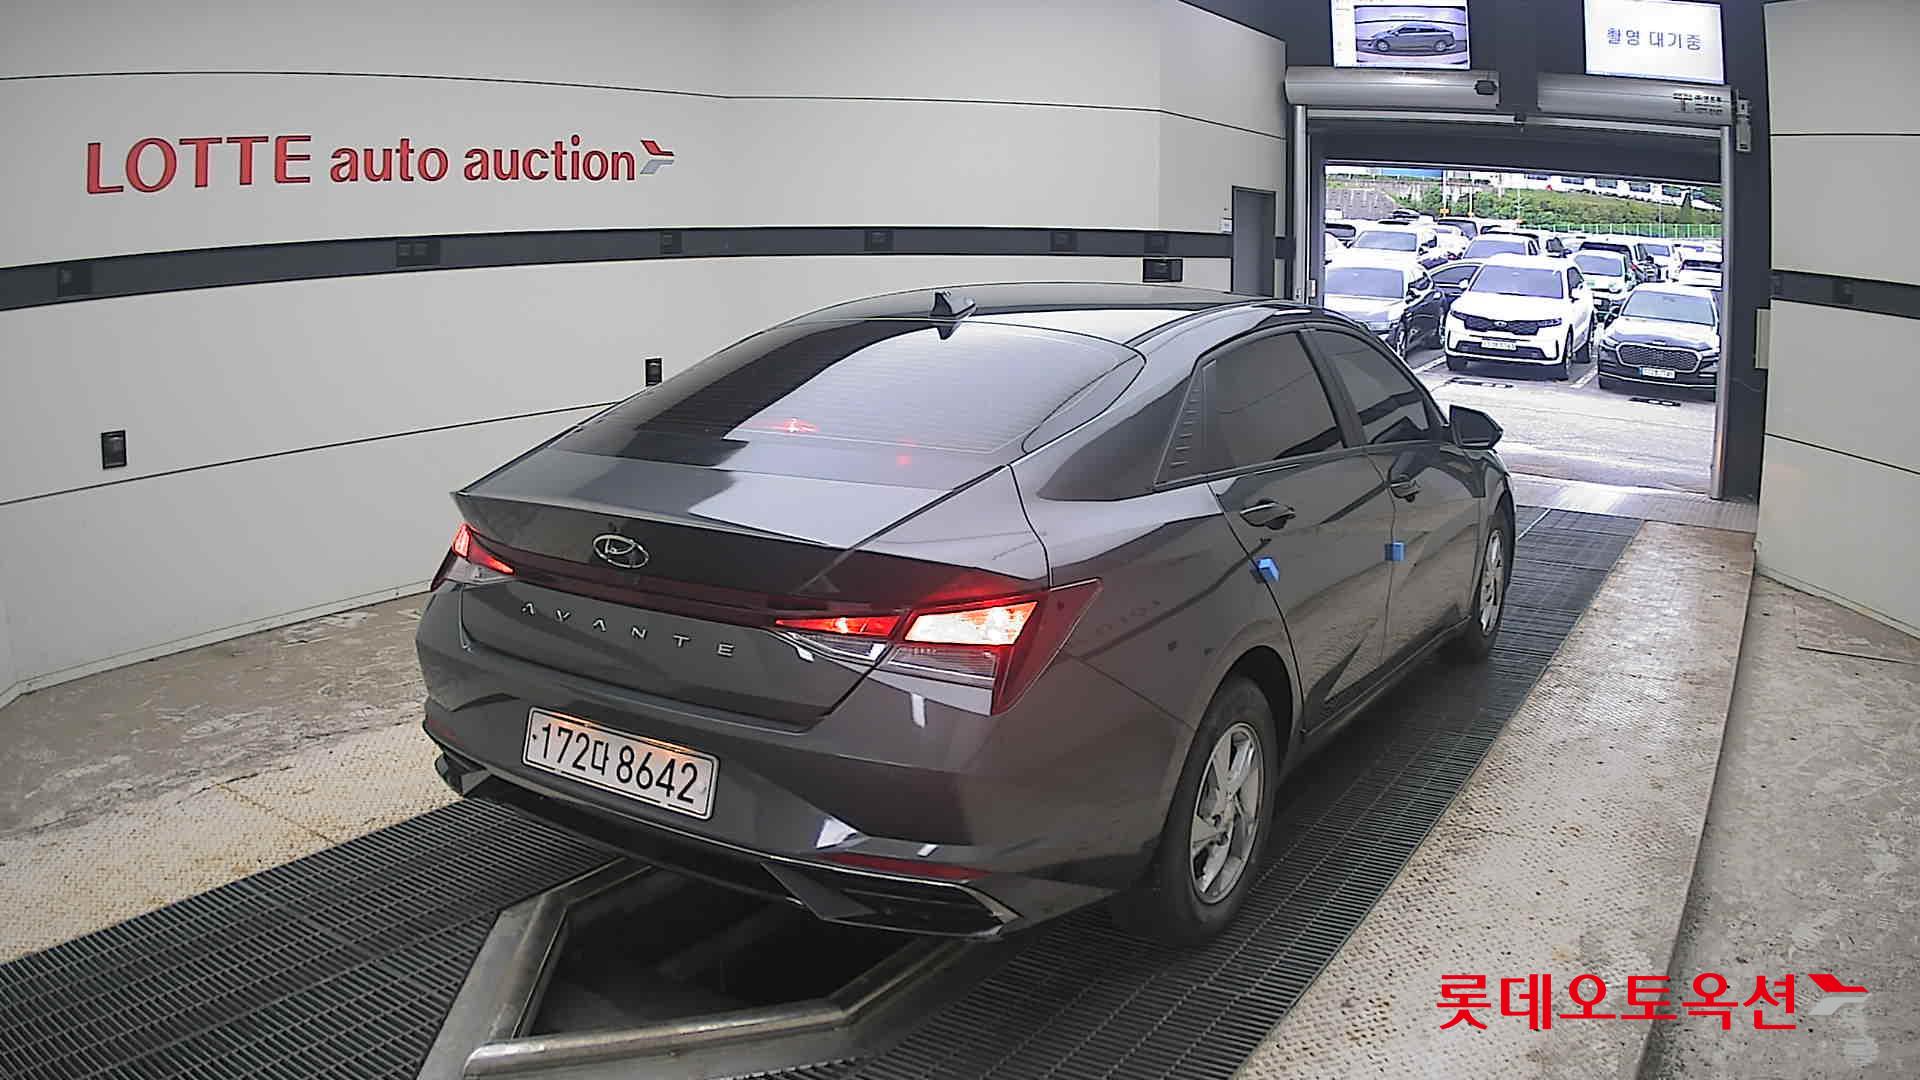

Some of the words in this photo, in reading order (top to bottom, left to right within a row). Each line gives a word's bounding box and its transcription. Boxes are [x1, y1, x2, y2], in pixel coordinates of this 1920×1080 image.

[1607, 27, 1640, 46] 촬영
[1649, 31, 1702, 51] 대기중
[86, 134, 311, 194] LOTTE
[329, 137, 449, 181] auto
[463, 134, 635, 181] auction
[521, 602, 735, 657] AVANTE
